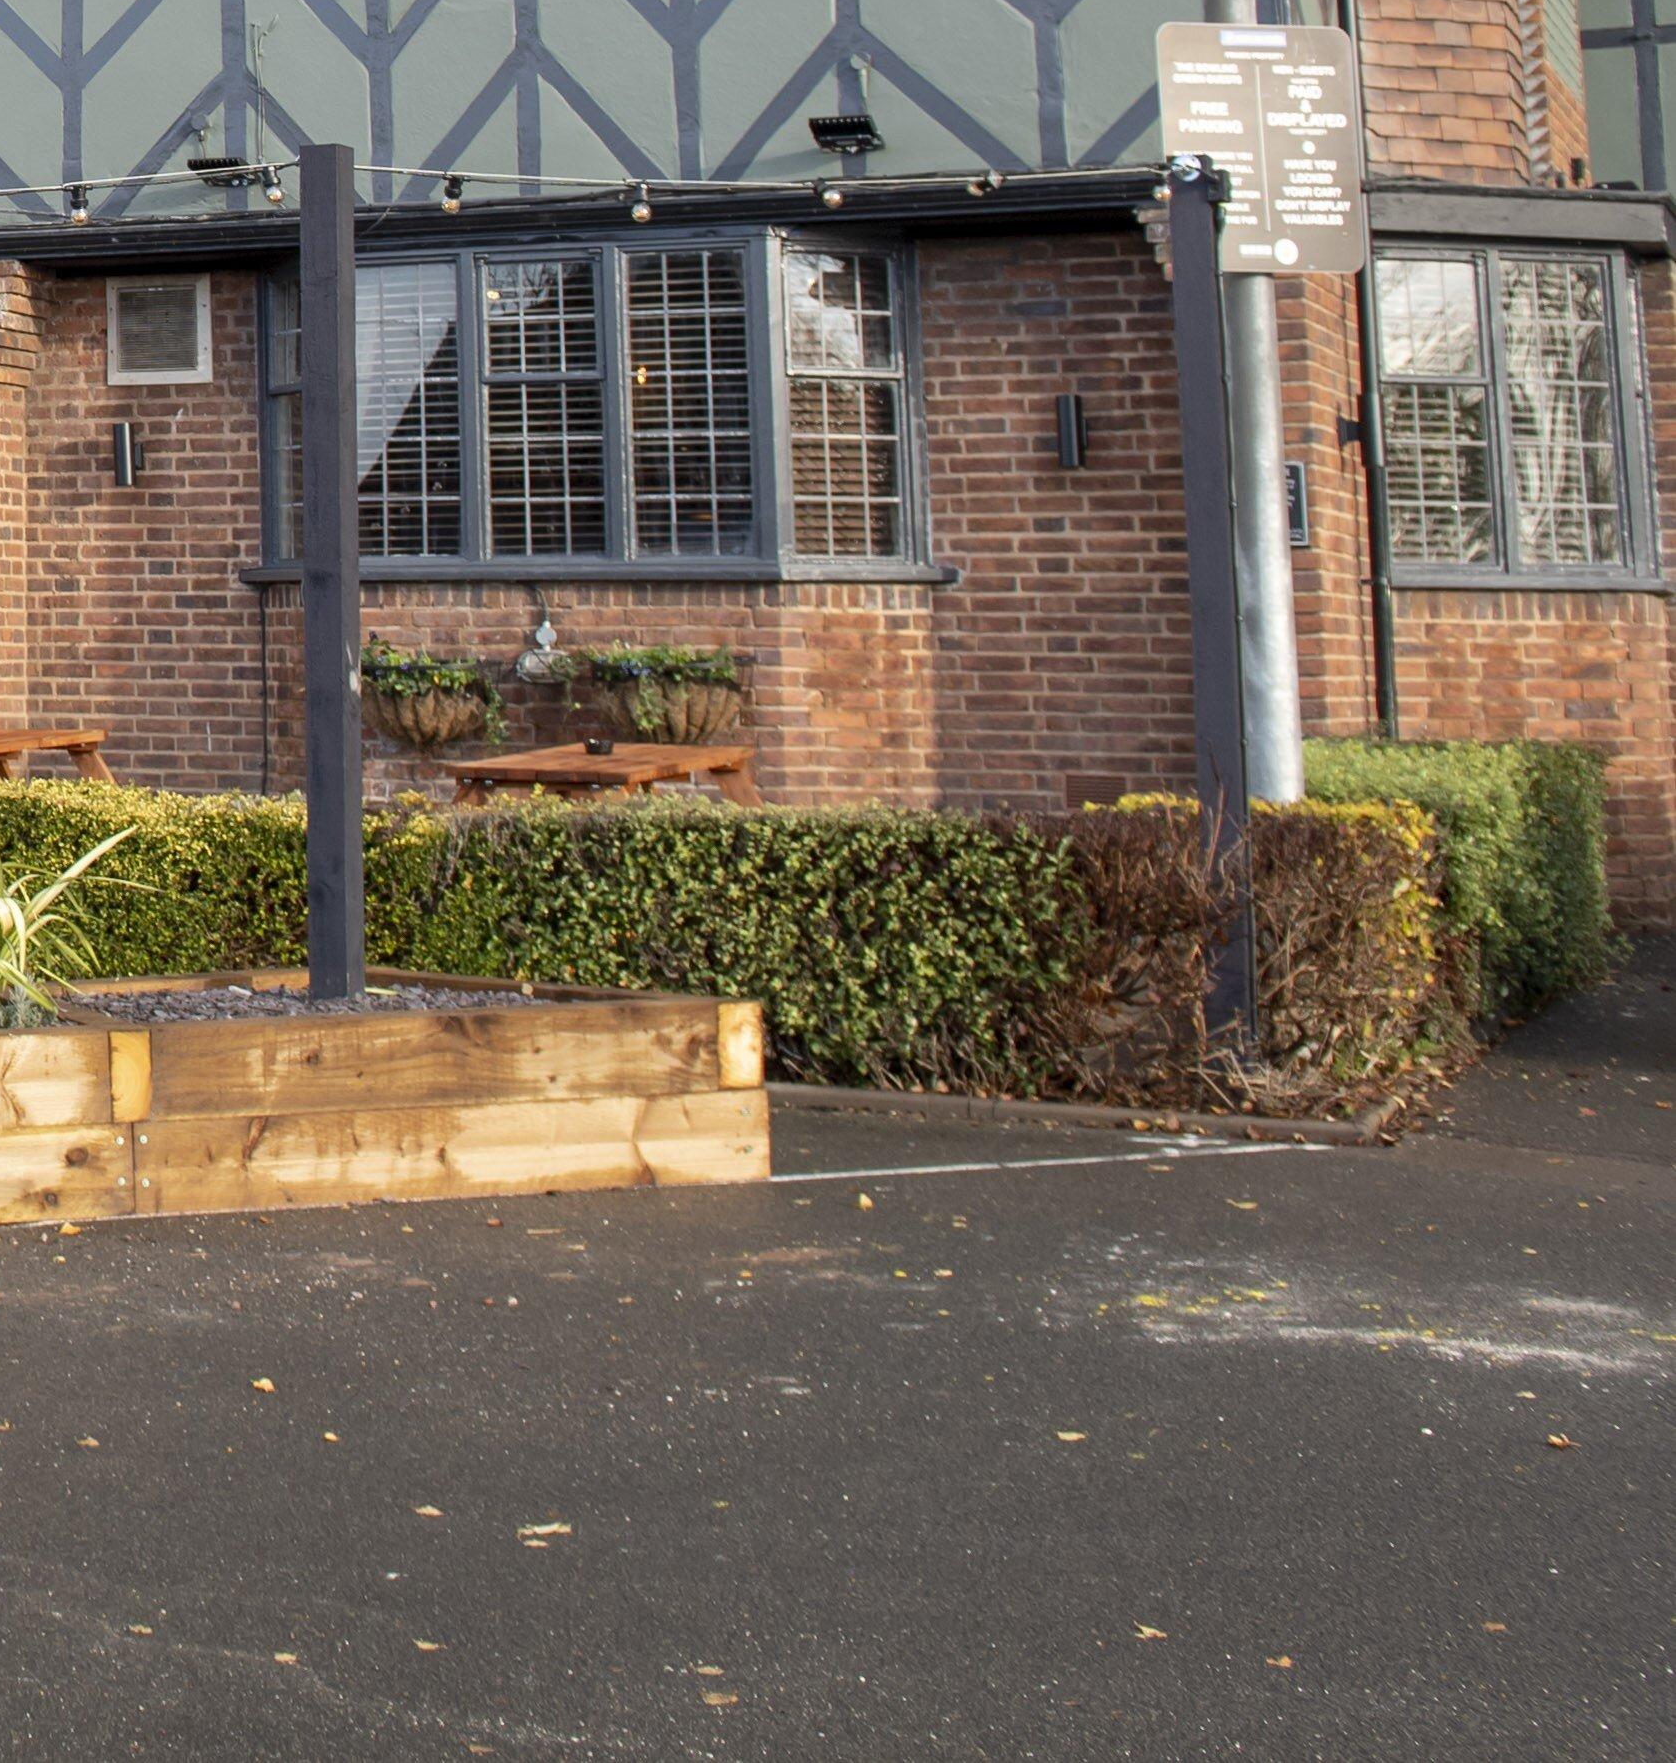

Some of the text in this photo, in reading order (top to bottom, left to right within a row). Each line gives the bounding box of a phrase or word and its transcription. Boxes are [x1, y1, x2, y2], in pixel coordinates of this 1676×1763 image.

[1288, 84, 1323, 99] PAID
[1190, 101, 1230, 117] FREE
[1178, 119, 1244, 135] PARKING
[1266, 112, 1348, 128] DISPLAYED
[1314, 160, 1337, 171] YOU
[1307, 200, 1351, 211] DISPLAY
[1282, 213, 1344, 226] VALUABLES
